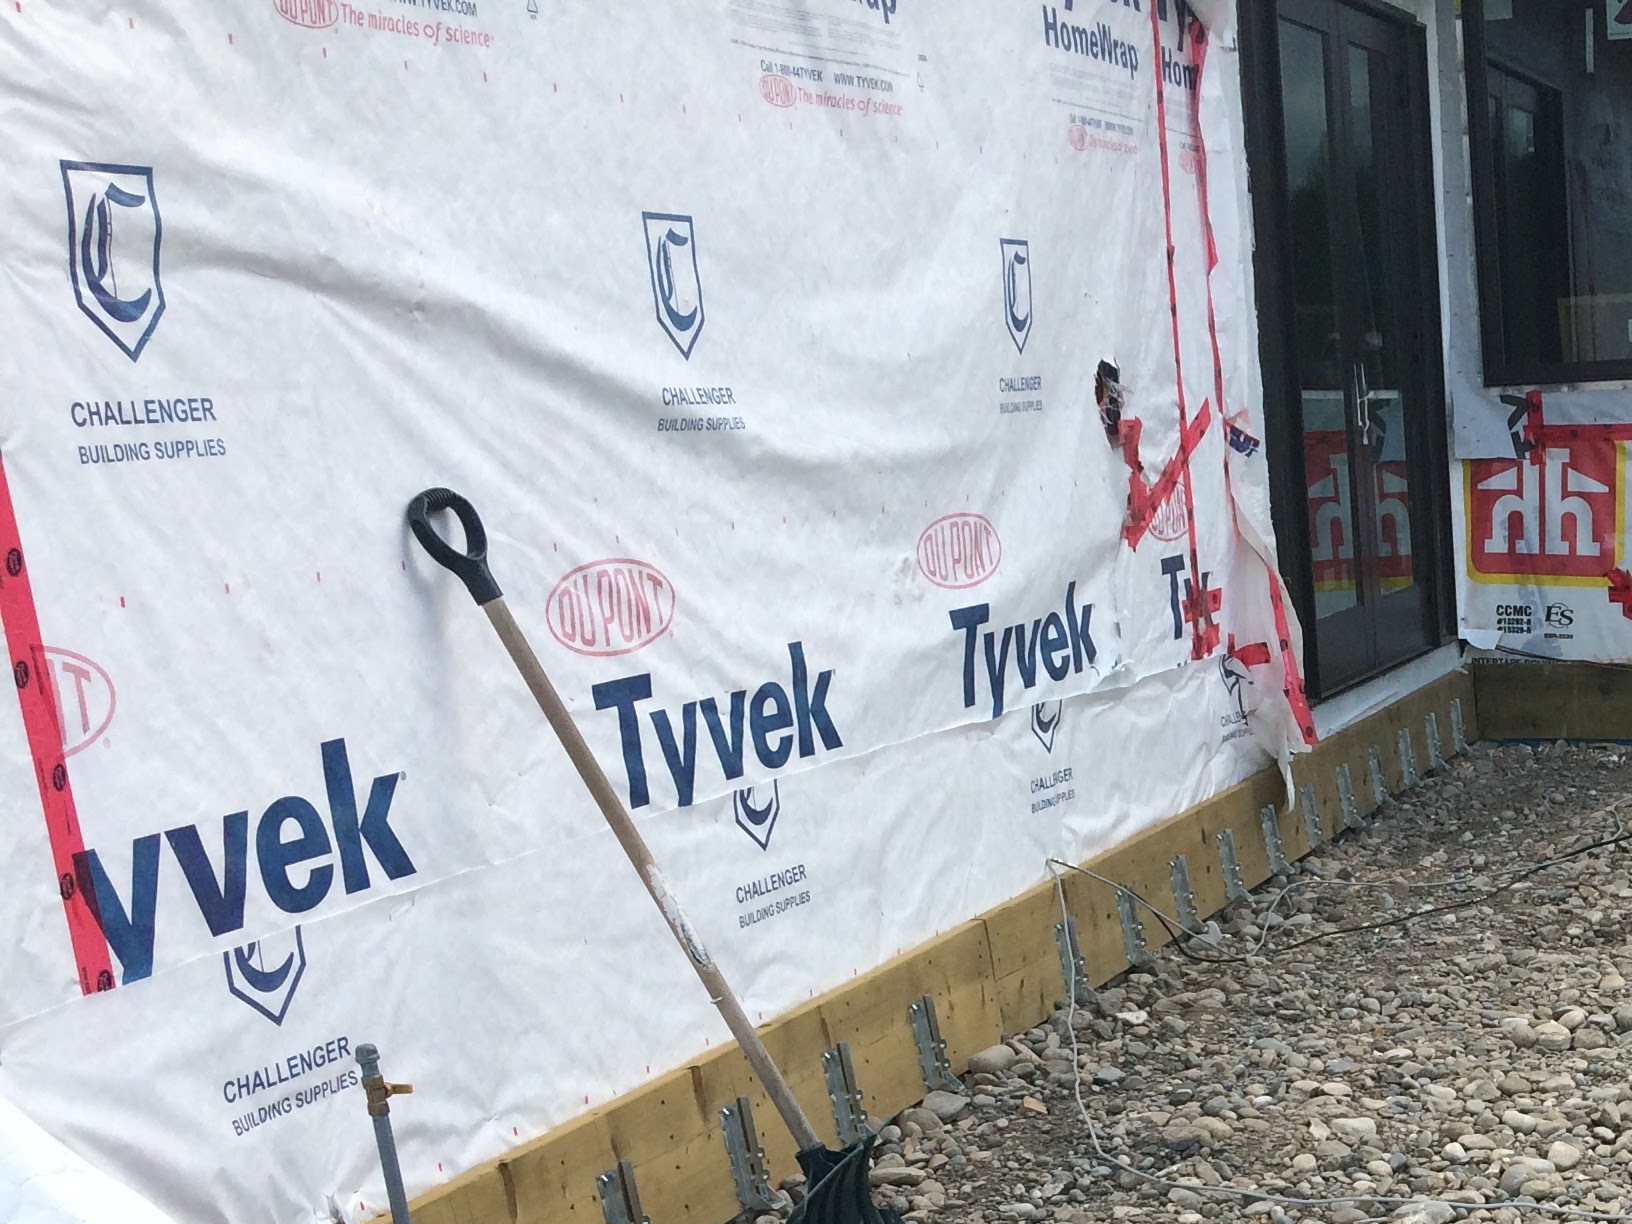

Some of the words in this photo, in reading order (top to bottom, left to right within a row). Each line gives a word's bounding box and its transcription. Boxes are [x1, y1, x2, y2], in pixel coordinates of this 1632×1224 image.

[340, 3, 364, 26] The
[368, 12, 420, 38] miracles
[423, 22, 443, 46] of
[445, 25, 491, 48] science
[1042, 4, 1139, 80] HomeWrap
[797, 87, 813, 105] The
[815, 92, 855, 111] miracles
[661, 386, 737, 406] CHALLENGER
[999, 375, 1042, 392] CHALLENGER
[70, 397, 217, 429] CHALLENGER
[657, 417, 704, 433] BUILDING
[705, 416, 747, 432] SUPPLIES
[78, 439, 151, 467] BUILDING
[154, 437, 228, 462] SUPPLIES
[1496, 604, 1532, 617] CCMC
[949, 580, 1098, 720] Tyvek
[592, 640, 844, 809] Tyvek
[735, 863, 808, 905] CHALLENGER
[738, 903, 776, 930] BUILDING
[775, 889, 812, 916] SUPPLIES
[223, 1035, 352, 1104] CHALLENGER
[231, 1096, 293, 1137] BUILDING
[294, 1069, 359, 1109] SUPPLIES
